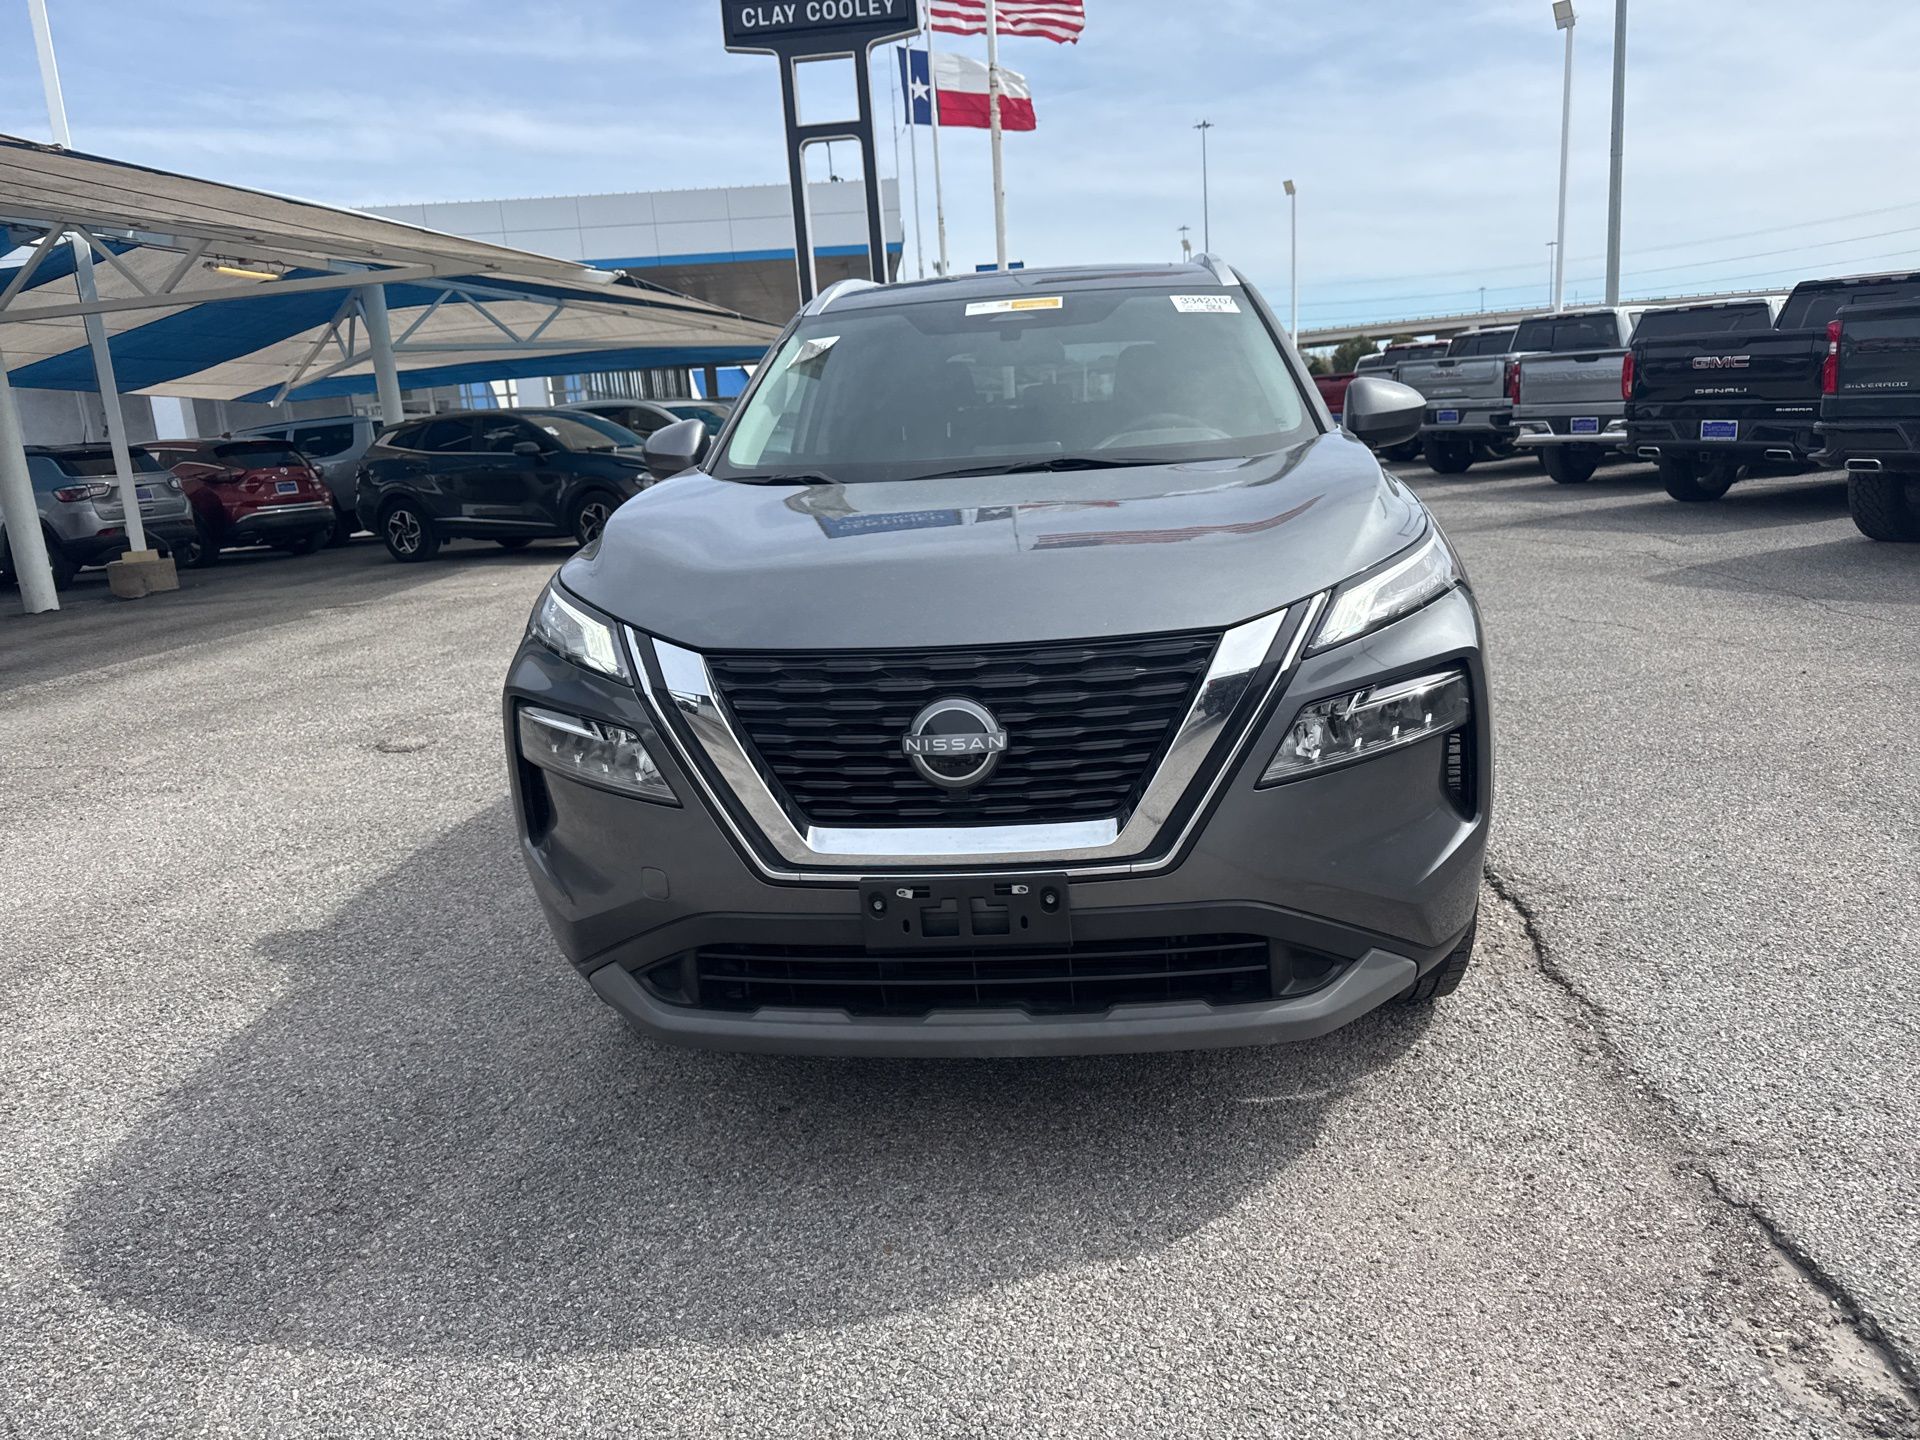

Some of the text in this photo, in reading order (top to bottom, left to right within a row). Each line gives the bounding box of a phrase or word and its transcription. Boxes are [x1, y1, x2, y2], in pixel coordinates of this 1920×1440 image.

[741, 0, 893, 27] CLAY COOLEY
[1693, 355, 1750, 369] GMC
[1844, 381, 1909, 389] SILVERADO
[906, 735, 1004, 751] NISSAN
